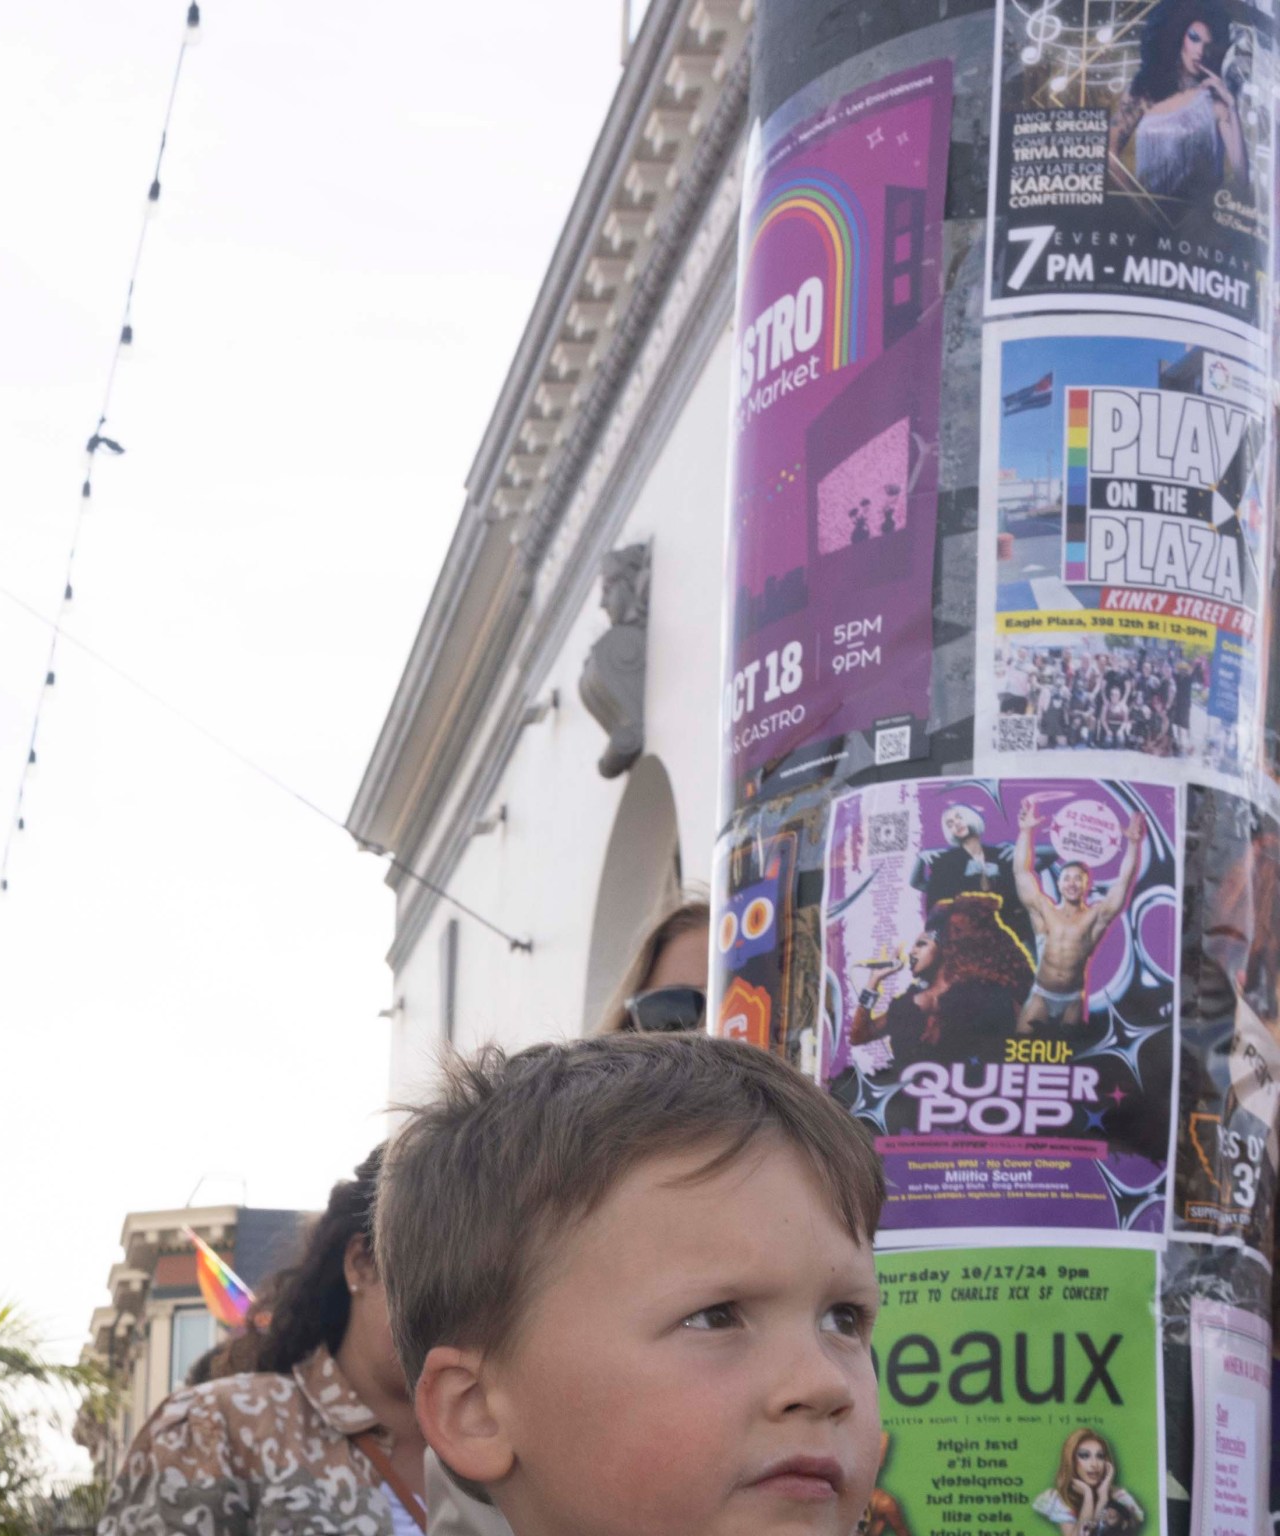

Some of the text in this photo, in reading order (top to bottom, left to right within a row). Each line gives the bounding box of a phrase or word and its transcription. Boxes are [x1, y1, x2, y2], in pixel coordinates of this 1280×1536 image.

[1013, 121, 1107, 135] DRINK SPECIALS
[1015, 110, 1107, 123] TWO FOR ONE
[1013, 145, 1105, 162] TRIVIA HOUR
[1010, 175, 1104, 195] KARAOKE
[1011, 163, 1104, 178] STAY LATE FOR
[1009, 192, 1103, 208] COMPETITION
[1054, 231, 1251, 272] EVERY MONDAY
[1123, 255, 1251, 309] MIDNIGHT
[739, 276, 824, 400] STRO
[747, 355, 820, 422] Market
[1090, 389, 1247, 487] PLAY
[1106, 481, 1188, 514] ON THE
[1089, 515, 1243, 604] PLAZA
[1105, 588, 1169, 613] KINKY
[1173, 596, 1229, 626] STREET
[833, 614, 883, 646] 5PM
[1005, 616, 1043, 629] Eagle
[1047, 616, 1088, 628] Plaza,
[1091, 617, 1114, 627] 398
[1119, 617, 1144, 629] 12th
[1148, 620, 1160, 631] St
[764, 641, 803, 703] 18
[832, 645, 882, 676] 9PM
[741, 703, 806, 749] CASTRO
[900, 1061, 1100, 1102] QUEER
[918, 1097, 1075, 1136] POP
[945, 1169, 1032, 1183] Militia Scunt
[1003, 1159, 1032, 1169] Cover
[1034, 1159, 1072, 1171] Charge
[878, 1266, 1089, 1284] hursday 10/17/24 9pm
[899, 1290, 918, 1305] TIX
[928, 1289, 941, 1303] TO
[951, 1287, 999, 1301] CHARLIE
[1008, 1286, 1030, 1300] XCX
[1040, 1286, 1053, 1300] SF
[1062, 1286, 1110, 1301] CONCERT
[872, 1330, 1124, 1407] eaux
